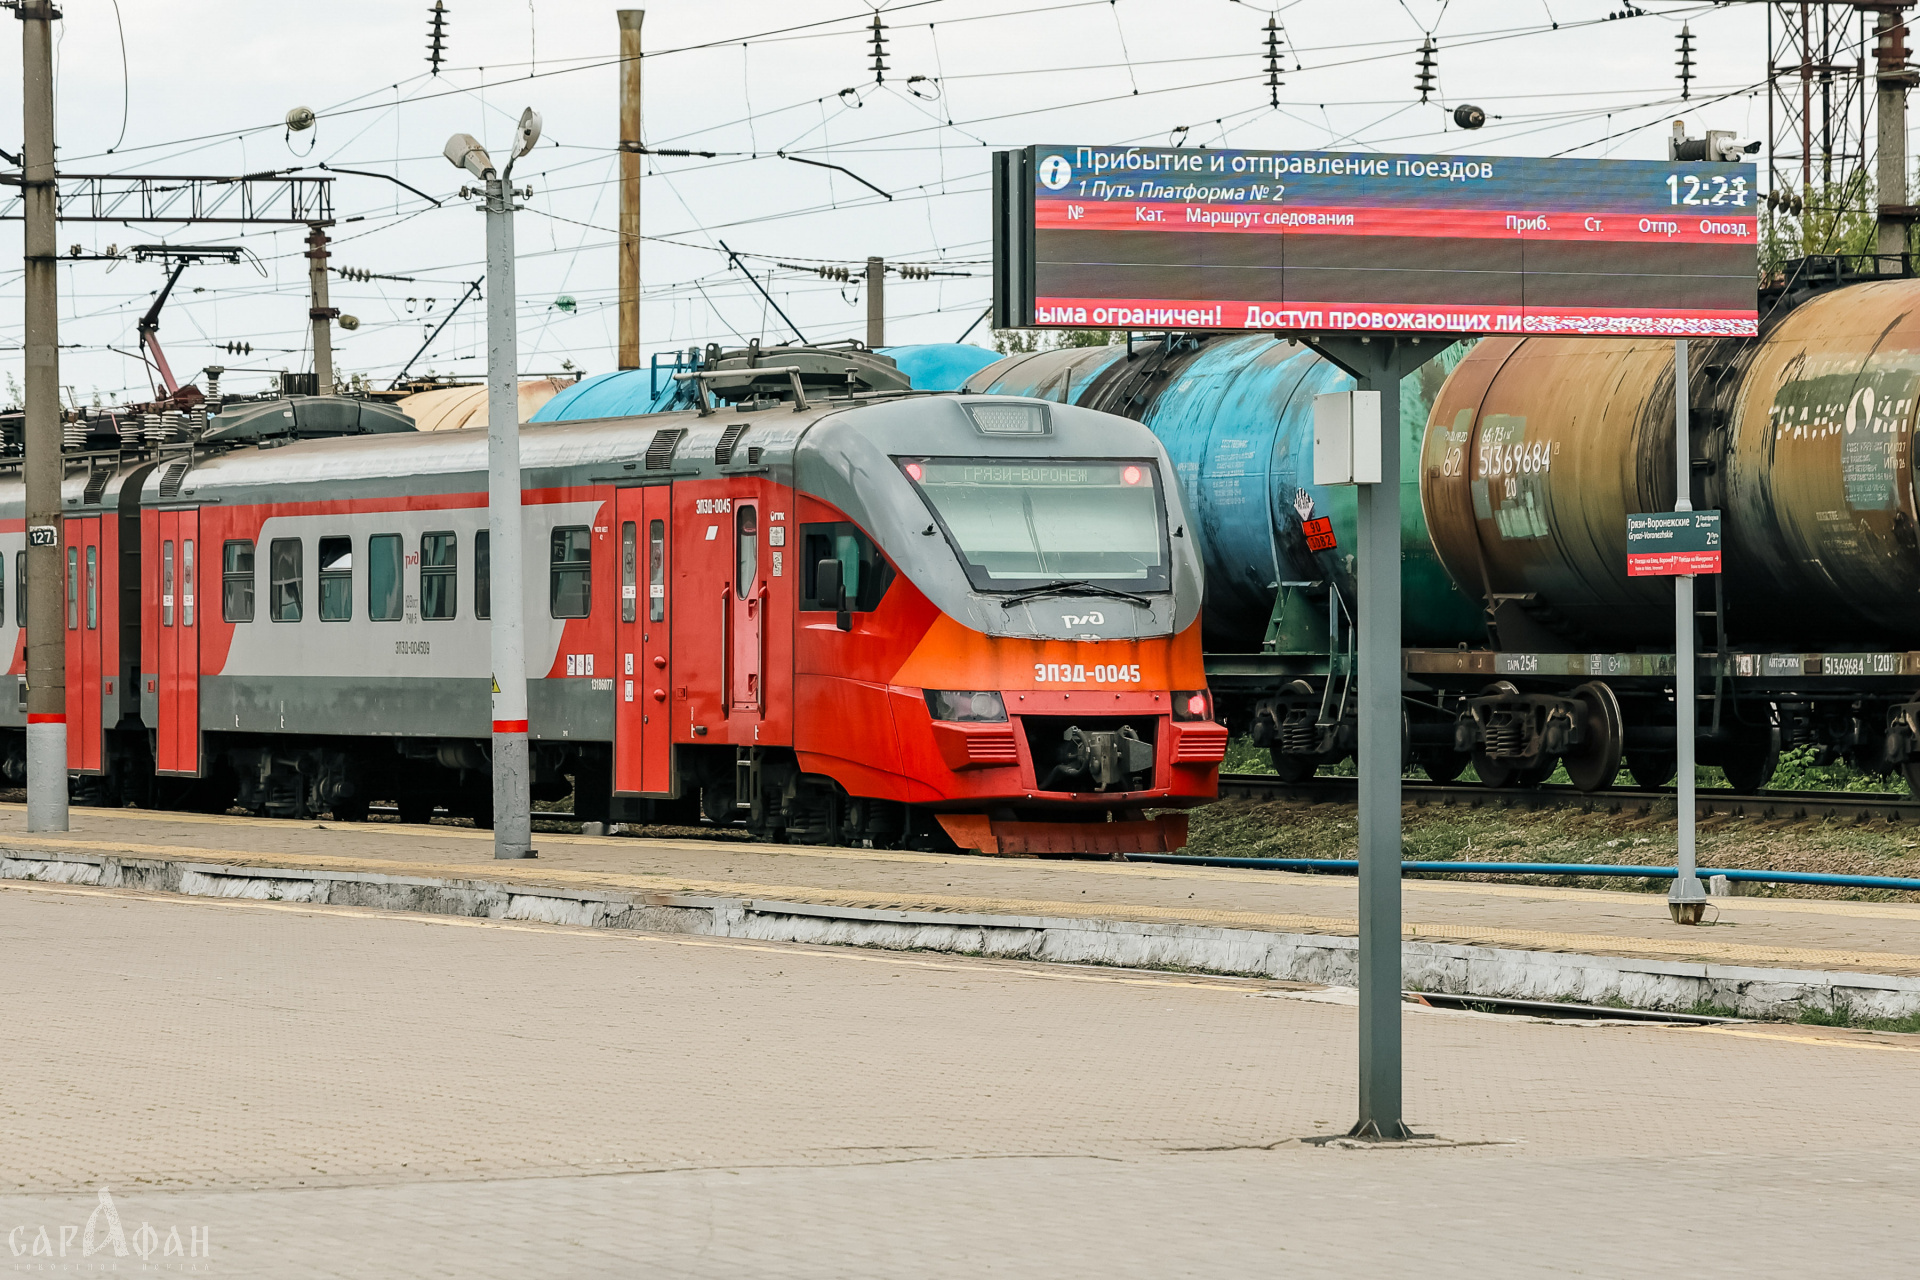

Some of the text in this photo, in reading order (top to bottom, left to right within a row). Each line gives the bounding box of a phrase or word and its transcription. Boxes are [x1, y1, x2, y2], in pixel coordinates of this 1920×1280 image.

[1076, 147, 1494, 181] Прибытие и отправление поездов
[1078, 181, 1285, 204] 1 Путь Платформа № 2
[1067, 204, 1751, 238] № Кат. Маршрут следования Приб. Ст. Отпр. Опозд.
[1093, 306, 1222, 327] ограничен!
[1244, 307, 1322, 330] Доступ
[1328, 311, 1490, 332] провожающих
[1443, 440, 1552, 477] 62 51369684
[963, 467, 1088, 482] ГРЯЗИ-ВОРОНЕЖ
[1309, 521, 1322, 534] 90
[1628, 517, 1690, 532] Грязи-Воронежские
[1695, 515, 1700, 528] 2
[32, 531, 52, 544] 127
[1824, 656, 1864, 675] 51369684
